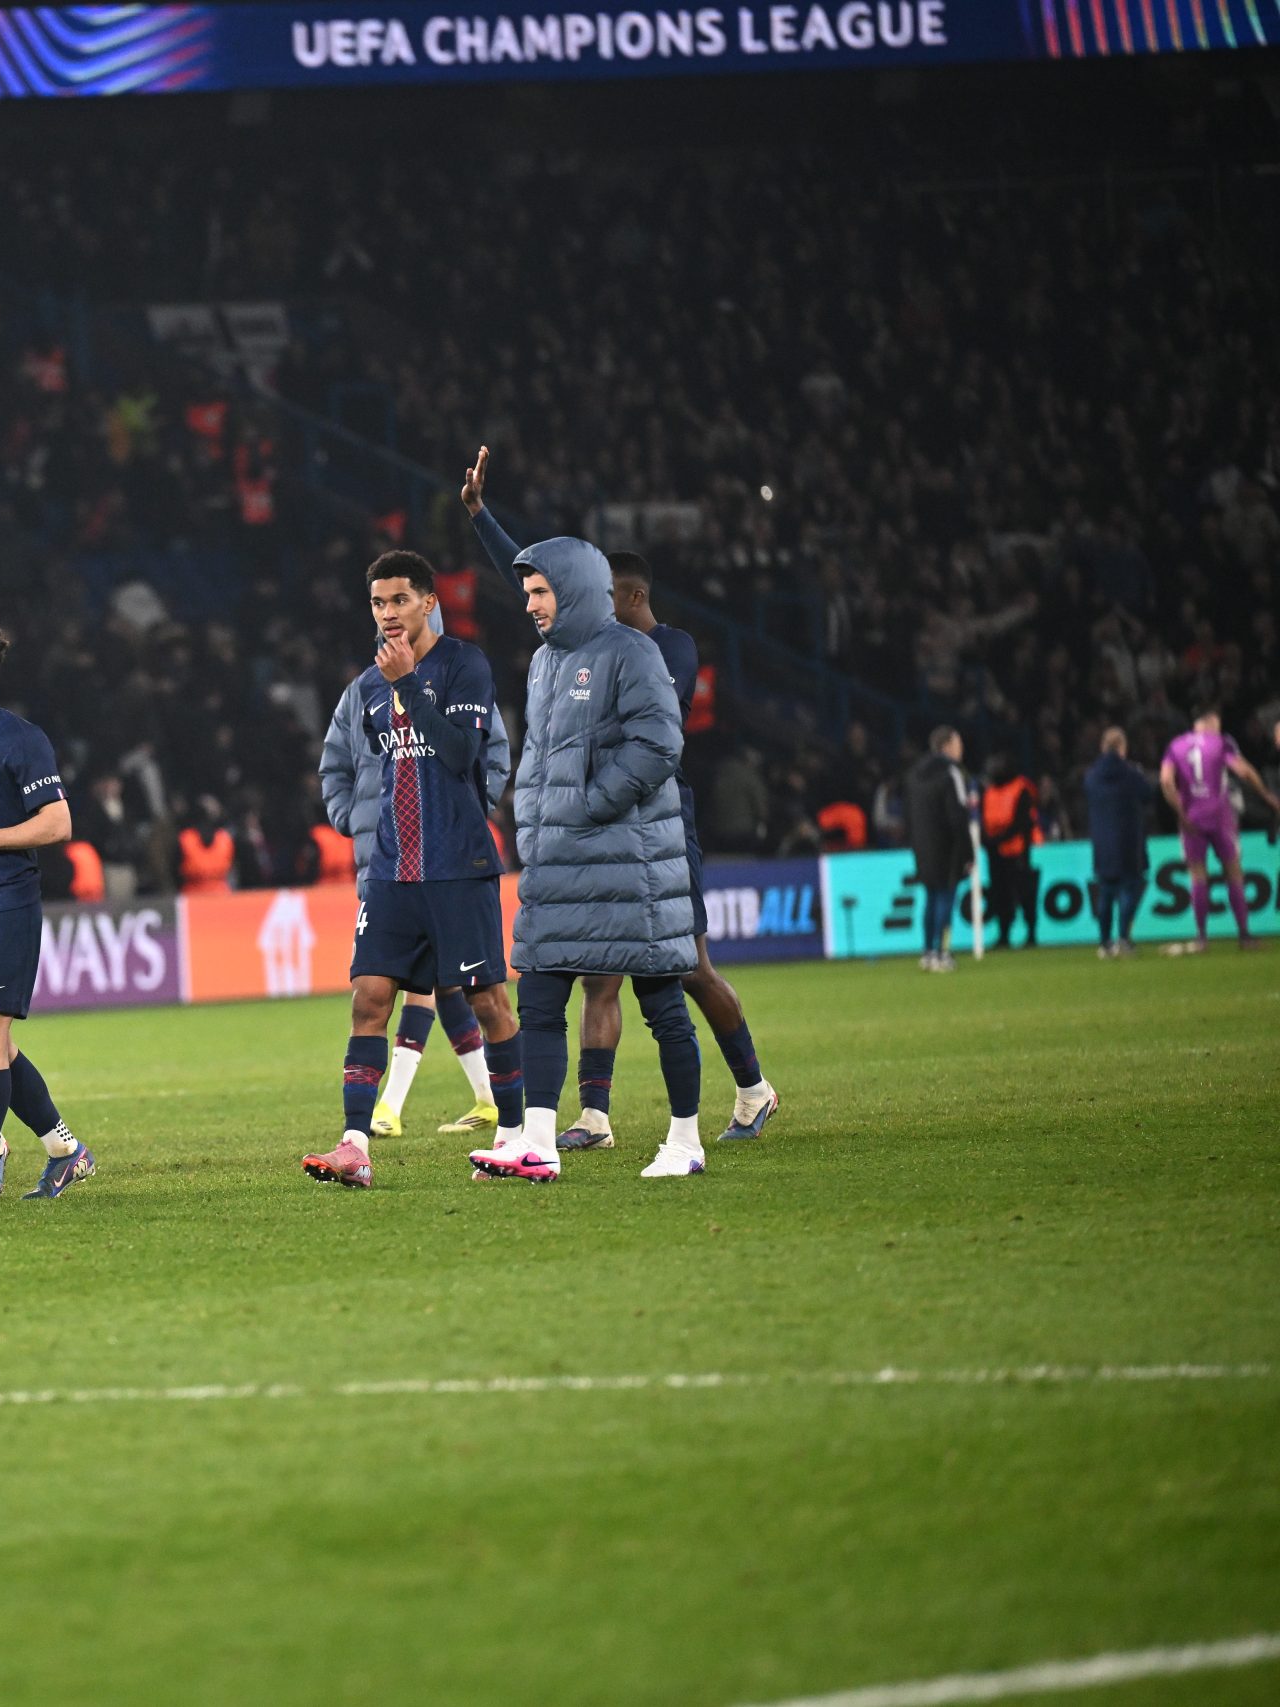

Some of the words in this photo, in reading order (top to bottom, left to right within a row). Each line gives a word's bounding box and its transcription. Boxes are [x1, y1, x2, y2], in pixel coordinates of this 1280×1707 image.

[292, 18, 417, 67] UEFA
[423, 8, 727, 65] CHAMPIONS
[738, 1, 947, 53] LEAGUE
[445, 703, 488, 716] BEYOND
[391, 745, 436, 760] AIRWAYS
